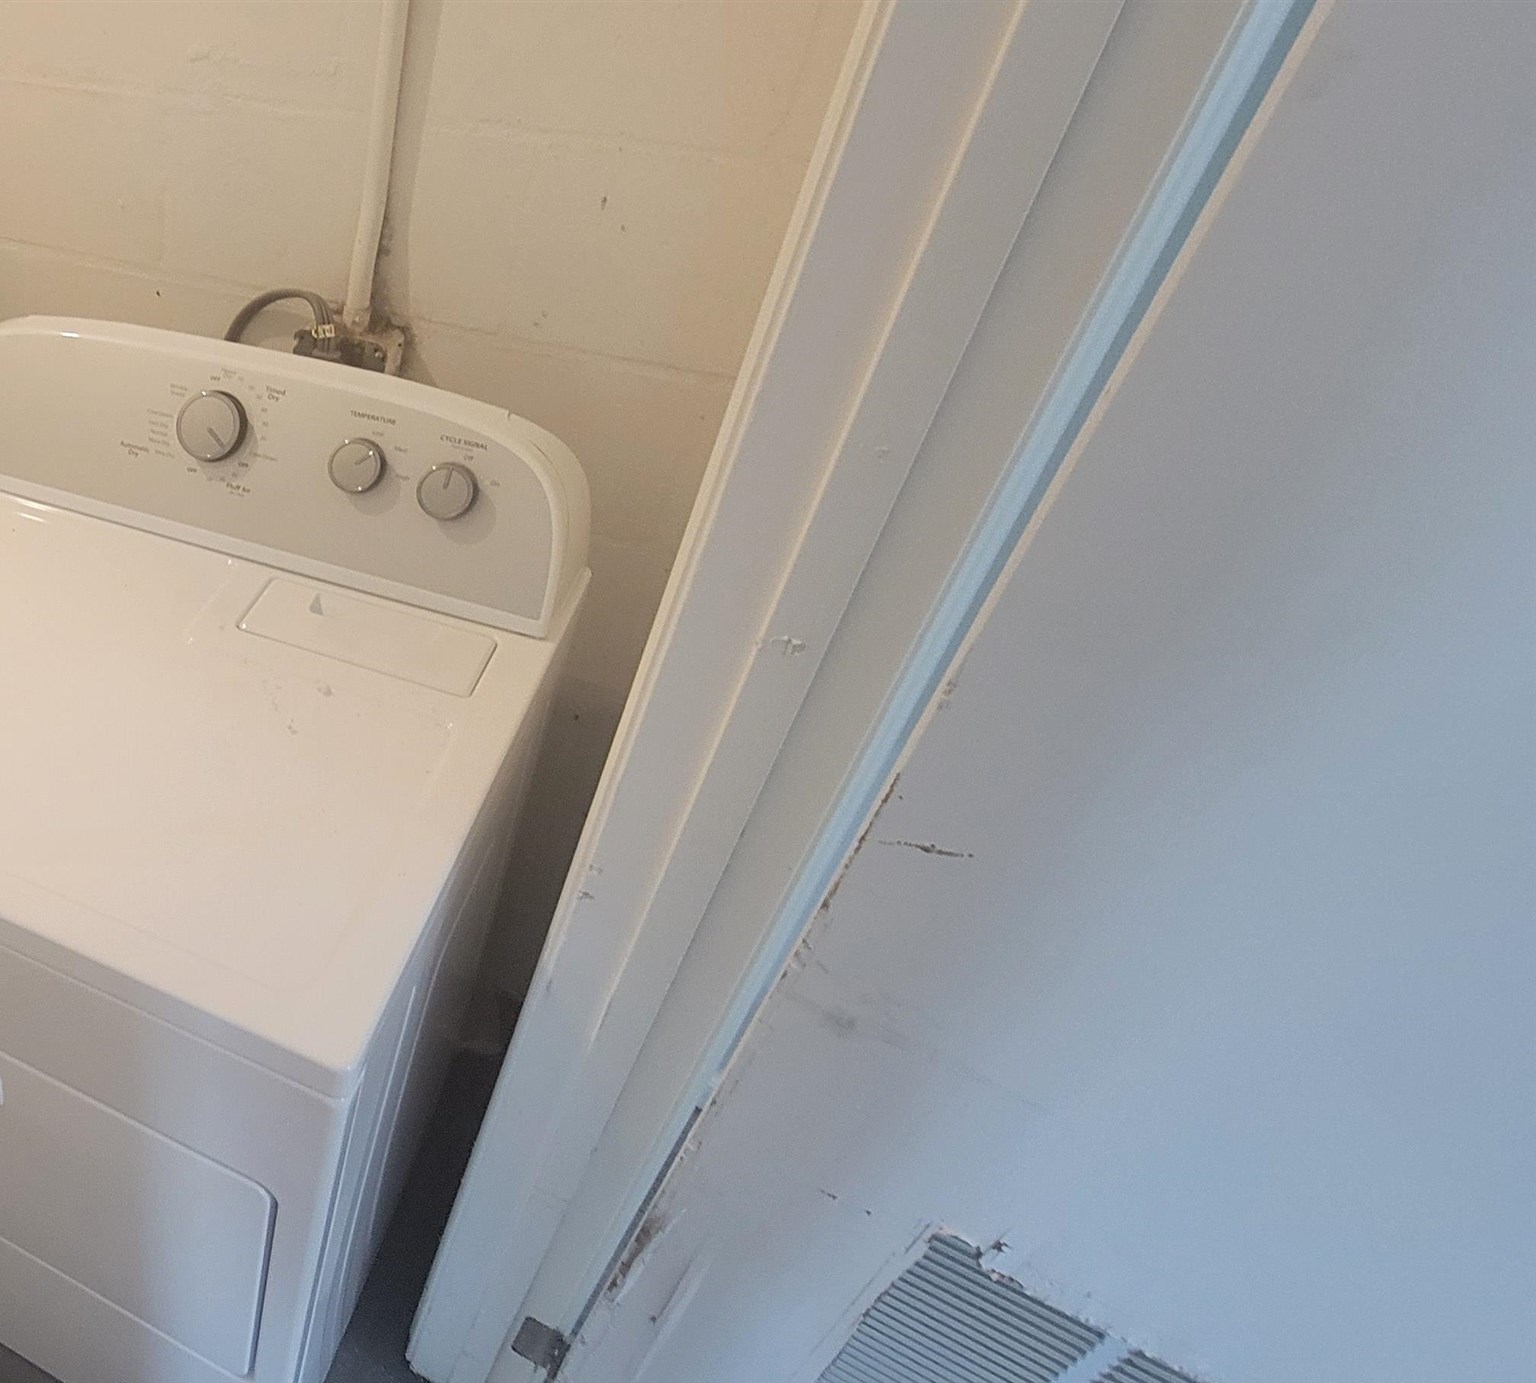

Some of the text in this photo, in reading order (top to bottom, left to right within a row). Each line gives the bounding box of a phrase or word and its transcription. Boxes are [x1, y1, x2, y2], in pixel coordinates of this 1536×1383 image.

[266, 385, 286, 396] Timed
[267, 394, 280, 402] Dry
[350, 410, 397, 426] TEMPERATURE
[440, 434, 462, 445] CYCLE
[463, 439, 488, 451] SIGNAL
